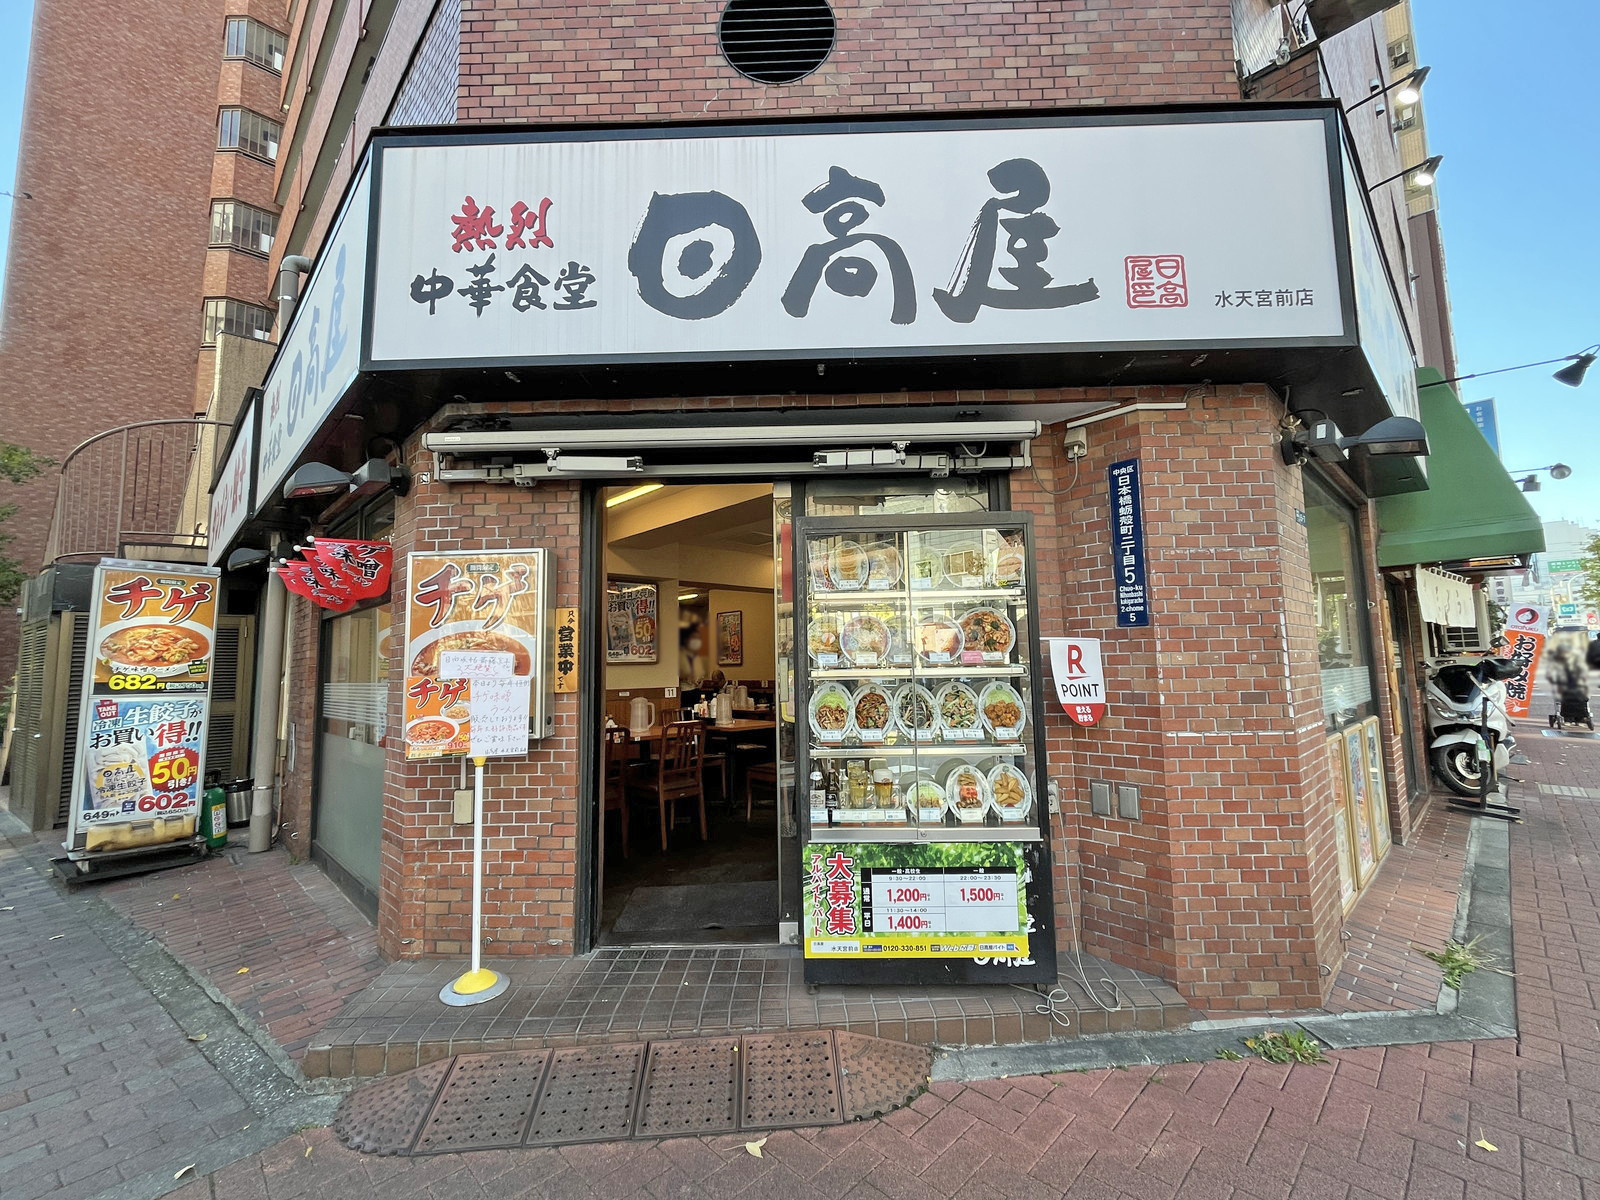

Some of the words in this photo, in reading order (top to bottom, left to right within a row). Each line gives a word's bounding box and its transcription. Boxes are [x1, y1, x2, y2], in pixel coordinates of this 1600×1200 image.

[450, 195, 554, 253] 熱烈
[628, 157, 1101, 325] 日高屋
[410, 253, 598, 317] 中華食堂
[1214, 287, 1314, 308] 水天宮前店
[1112, 465, 1135, 476] 中央区
[1124, 567, 1136, 584] 5
[415, 563, 529, 629] チゲ
[1119, 584, 1143, 592] Chuo-ku
[106, 575, 211, 625] チゲ
[568, 610, 575, 625] 只今
[1130, 612, 1137, 622] 5
[557, 625, 576, 676] 営業中
[1067, 644, 1087, 674] R
[108, 674, 166, 691] 682円
[557, 675, 564, 690] です
[1061, 684, 1099, 697] POINT
[407, 677, 469, 710] チゲ
[667, 688, 674, 697] 11
[98, 705, 117, 713] TAKE
[123, 700, 202, 725] 生餃子が
[94, 719, 121, 730] 冷凍
[89, 720, 203, 749] お買い得!!
[152, 757, 197, 784] 50円
[138, 792, 196, 812] 602円
[83, 810, 115, 821] 649円
[811, 854, 823, 936] アルバイト・パート
[826, 852, 855, 934] 大募集
[886, 888, 928, 904] 1,200円
[960, 887, 1001, 903] 1,500円
[863, 911, 872, 928] 平日
[887, 915, 929, 931] 1,400円
